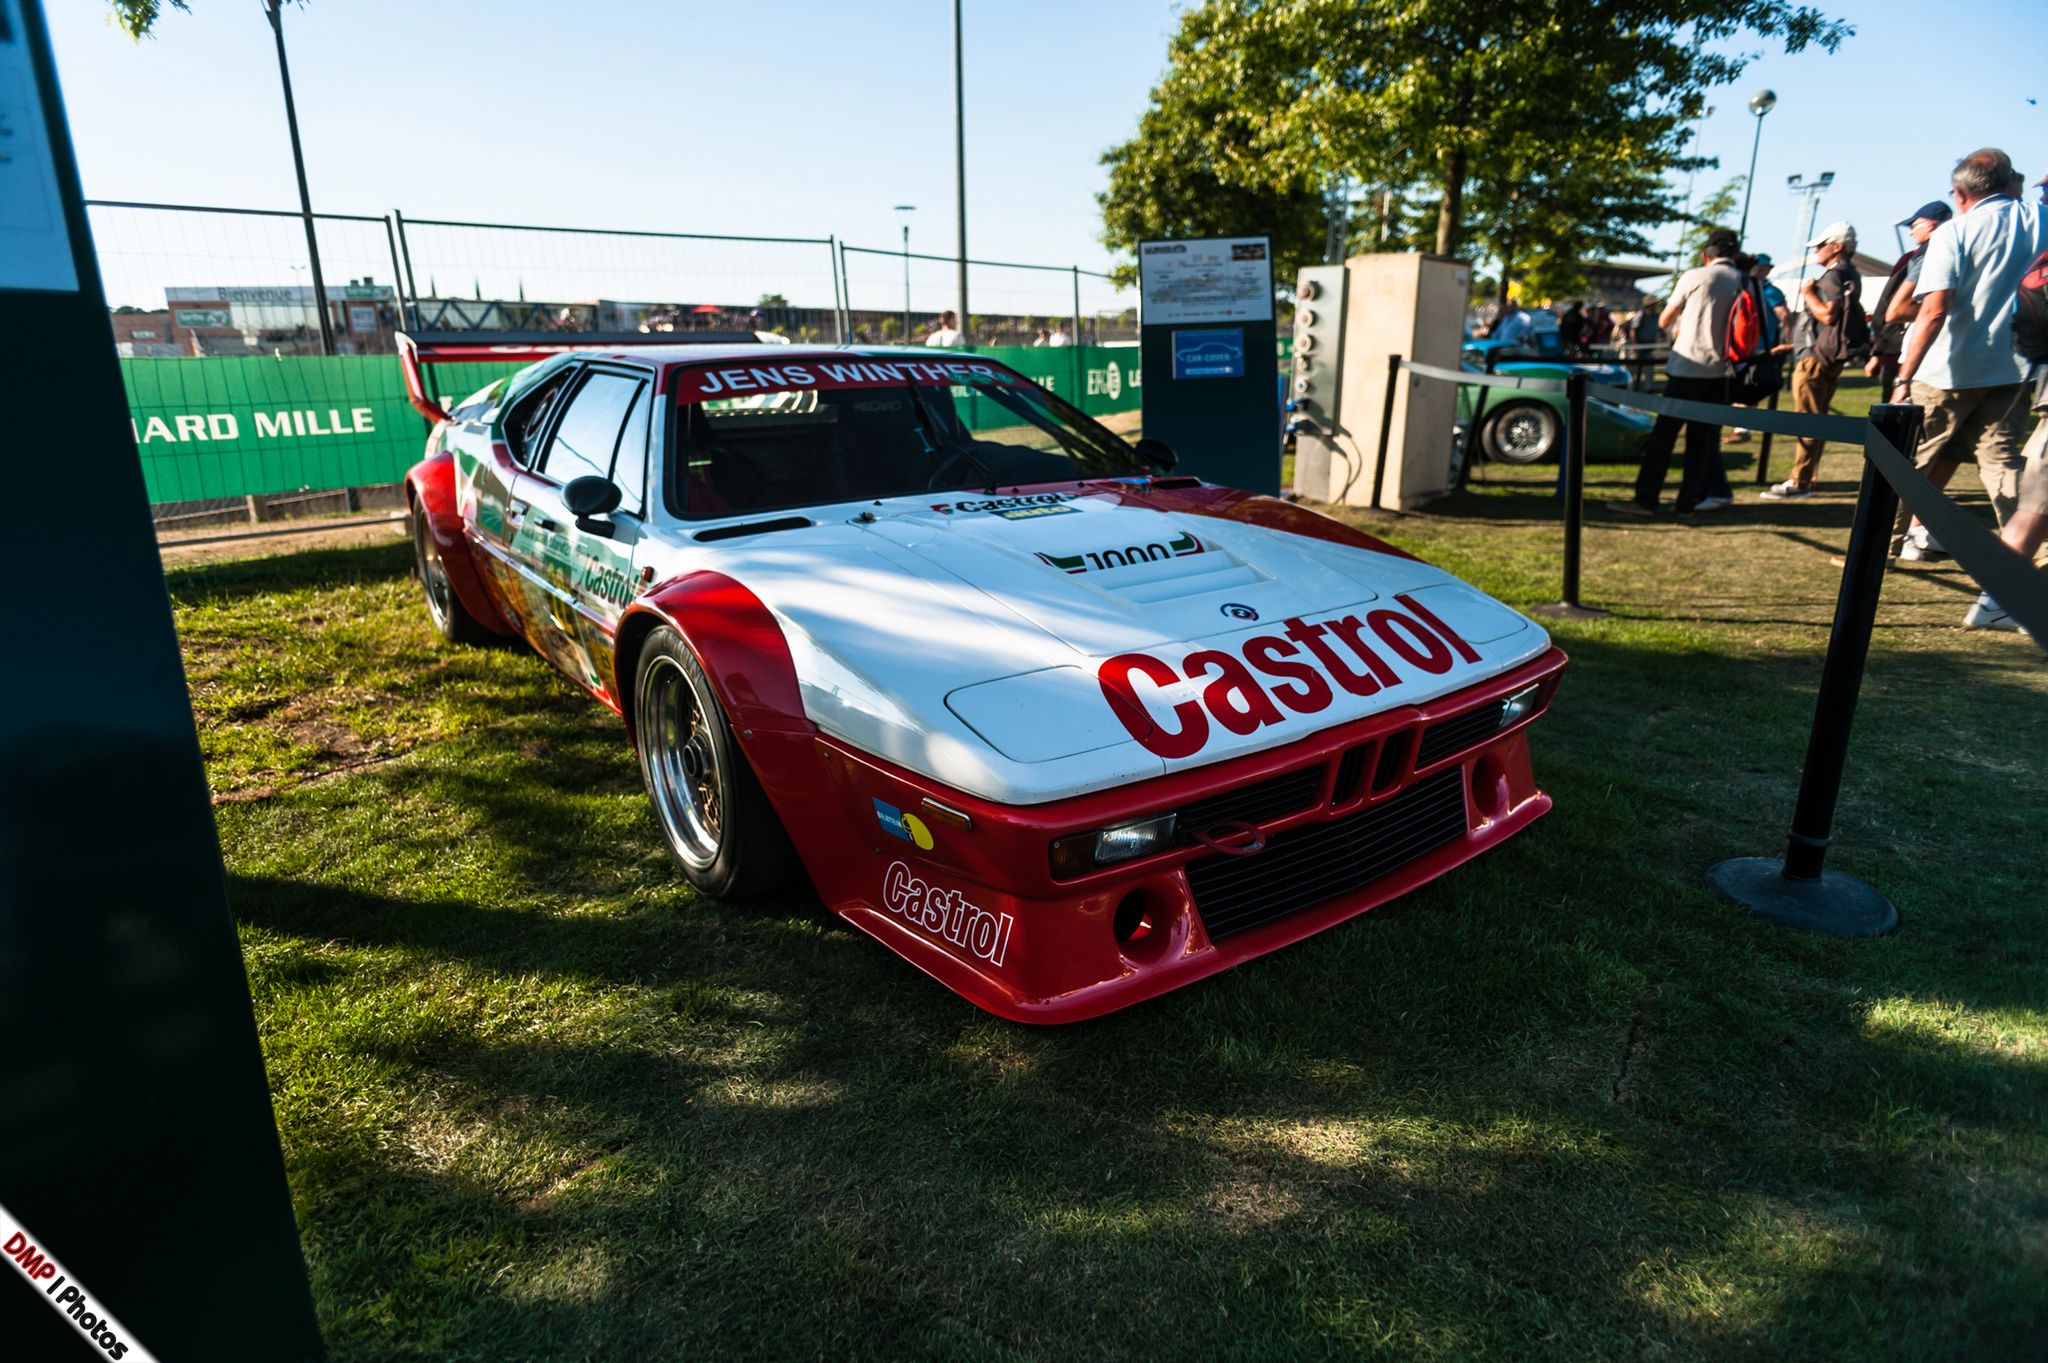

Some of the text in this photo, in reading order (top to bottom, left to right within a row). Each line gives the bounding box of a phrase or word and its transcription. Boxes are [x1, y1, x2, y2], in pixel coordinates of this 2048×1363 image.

[217, 286, 292, 301] Bienvenue
[700, 363, 996, 393] JENS WINTHER
[254, 407, 375, 438] MILLE
[956, 492, 1066, 513] Castrol
[1086, 543, 1171, 570] 1000
[1098, 594, 1483, 759] Castrol
[883, 861, 1014, 967] Castrol
